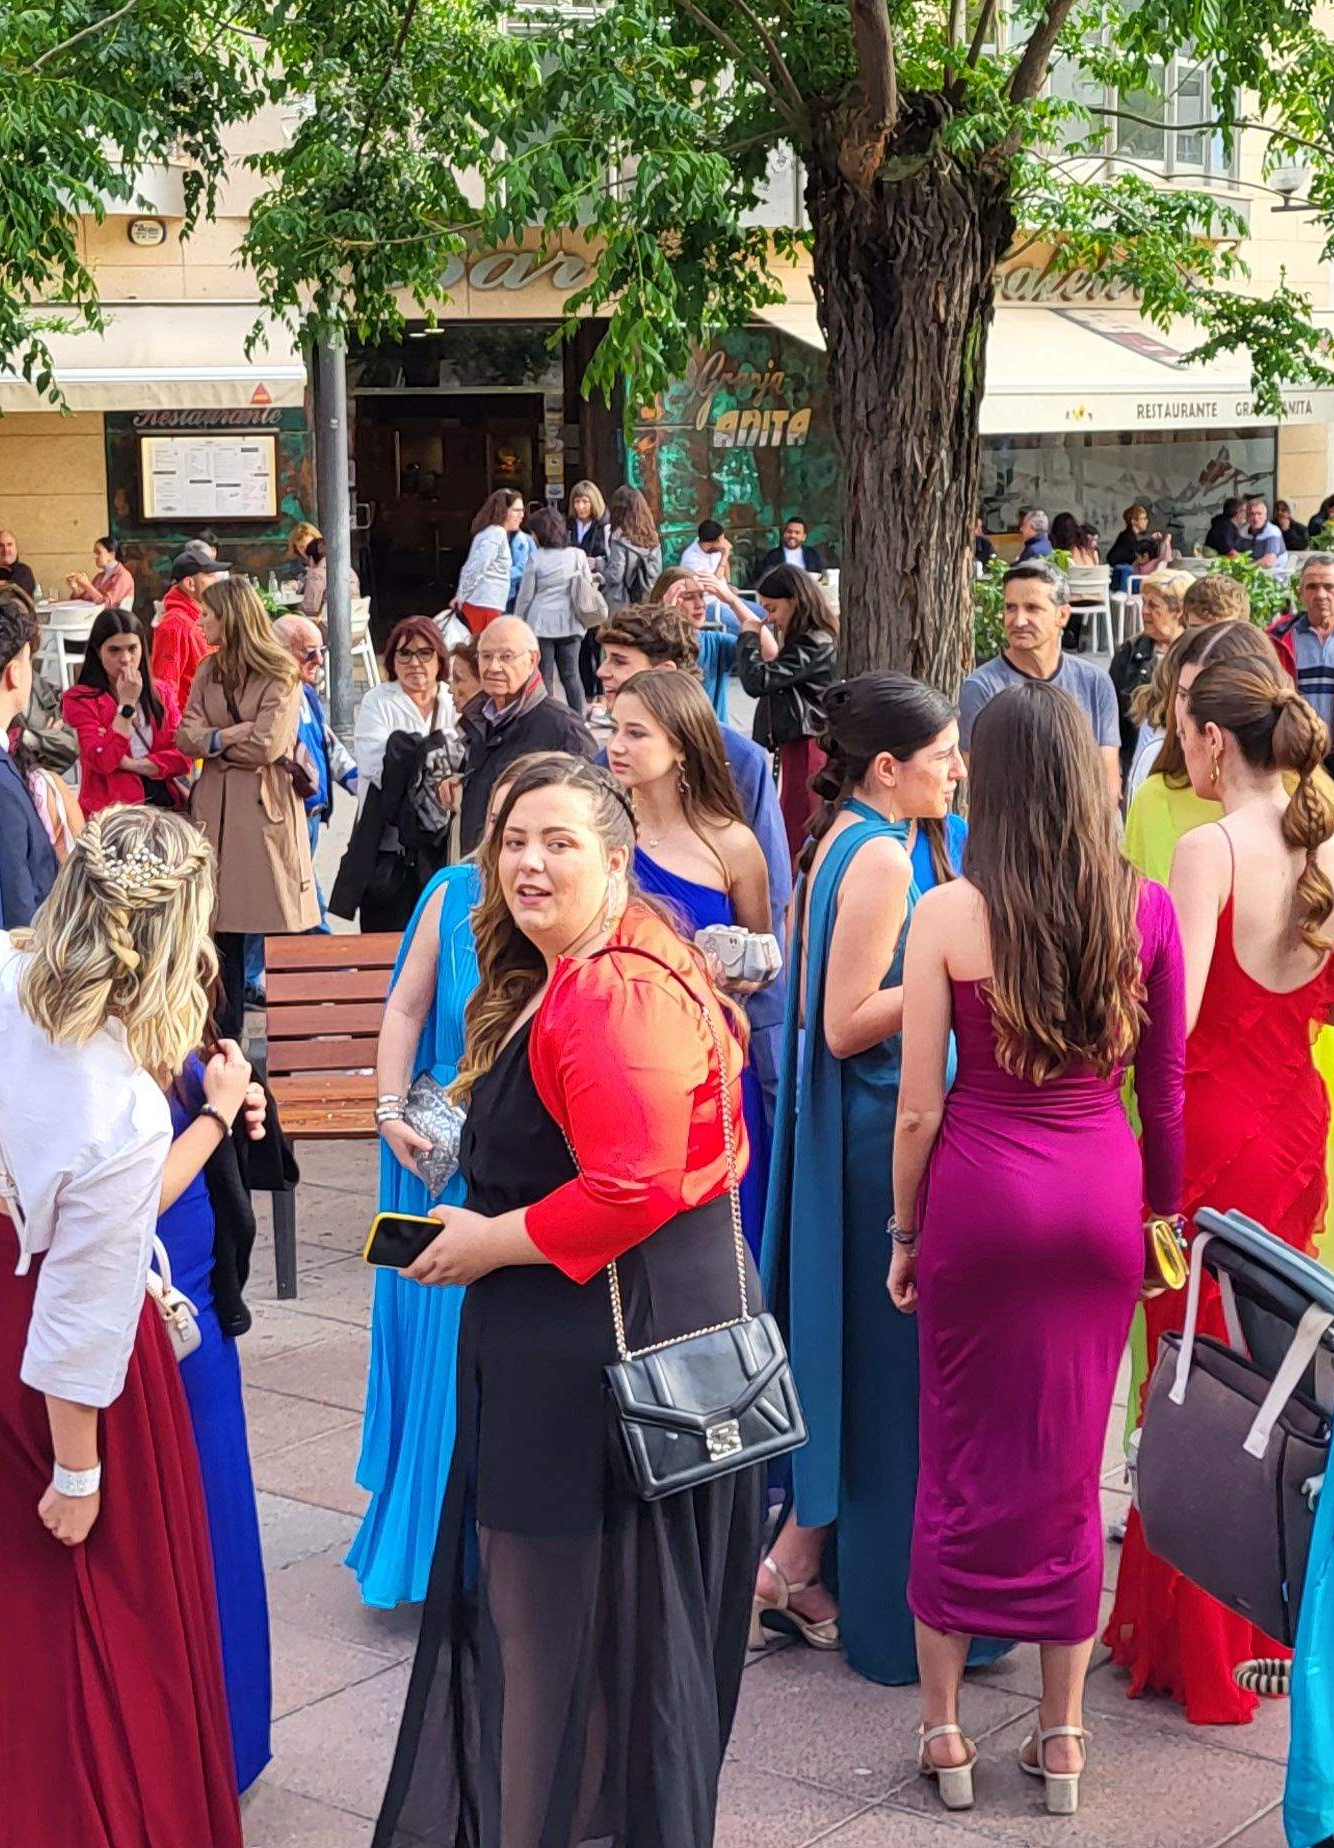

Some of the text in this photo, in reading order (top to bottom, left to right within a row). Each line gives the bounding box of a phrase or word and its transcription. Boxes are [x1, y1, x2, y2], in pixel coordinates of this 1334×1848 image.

[1136, 402, 1218, 420] RESTAURANTE
[1284, 400, 1313, 416] NITA
[713, 408, 812, 448] ANITA
